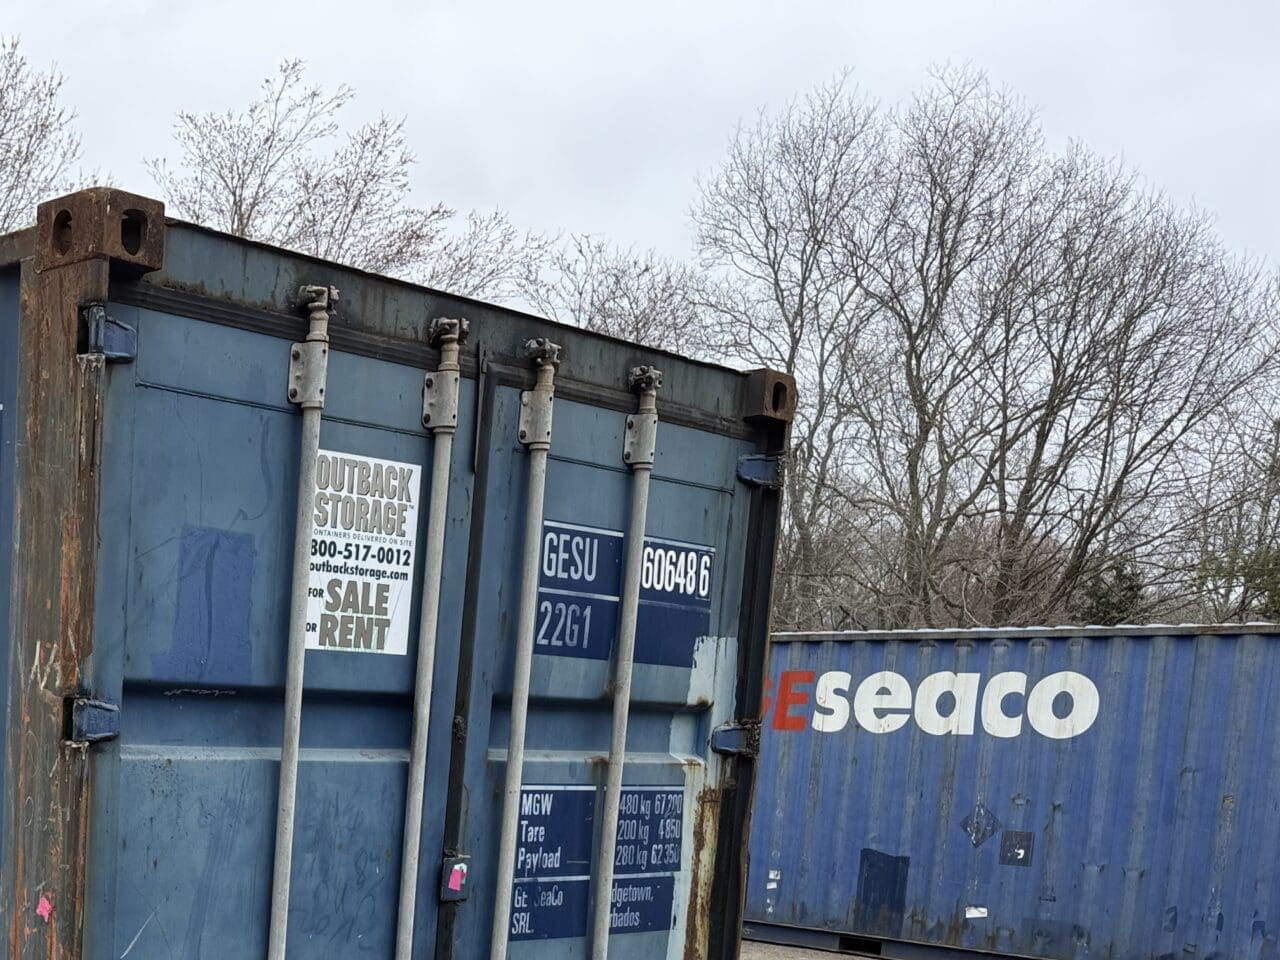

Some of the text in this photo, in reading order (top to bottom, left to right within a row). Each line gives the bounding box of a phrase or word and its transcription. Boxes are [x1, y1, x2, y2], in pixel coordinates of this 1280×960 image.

[316, 454, 413, 502] OUTBACK
[314, 491, 407, 537] STORAGE
[314, 528, 351, 540] ONTAINERS
[353, 531, 387, 543] DELIVERED
[400, 538, 412, 547] SITE
[543, 532, 710, 597] GESU 60648 6
[308, 578, 390, 617] FOR SALE
[306, 613, 391, 650] OR RENT
[536, 600, 592, 649] 22G1
[521, 793, 553, 816] MGW
[640, 794, 651, 820] kg
[521, 820, 545, 842] Tare
[638, 820, 650, 845] kg
[517, 846, 561, 874] Payload
[636, 845, 648, 870] kg
[611, 882, 653, 907] dgetown,
[609, 907, 640, 928] rbados
